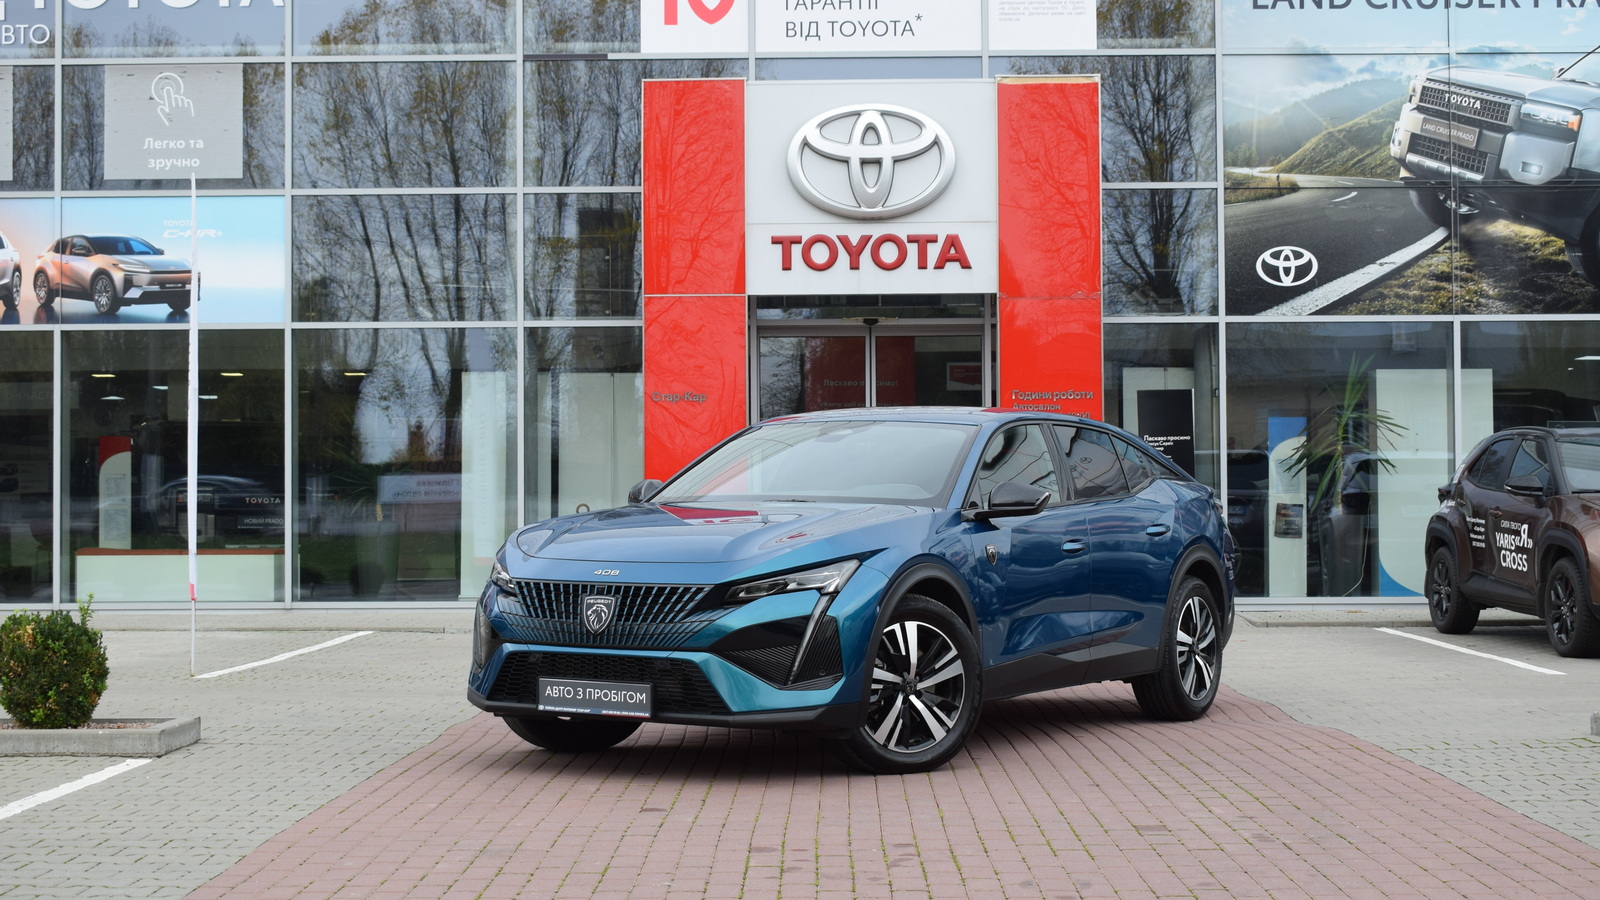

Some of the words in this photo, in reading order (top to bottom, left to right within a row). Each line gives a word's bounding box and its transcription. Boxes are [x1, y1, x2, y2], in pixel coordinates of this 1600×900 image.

[785, 21, 821, 41] ВІД
[1445, 93, 1481, 109] TOYOTA
[1422, 122, 1436, 131] LAND
[1457, 130, 1475, 141] PRADO
[143, 137, 186, 149] Легко
[188, 139, 205, 149] та
[147, 158, 200, 170] зручно
[771, 233, 973, 271] TOYOTA
[651, 391, 707, 404] Стар-Кар
[1012, 389, 1052, 401] Години
[1053, 388, 1094, 401] роботи
[1012, 402, 1061, 411] Автосалон
[1495, 532, 1515, 550] YARIS
[1500, 550, 1527, 571] CROSS
[545, 685, 574, 698] АВТО
[586, 688, 646, 704] ПРОБІГОМ
